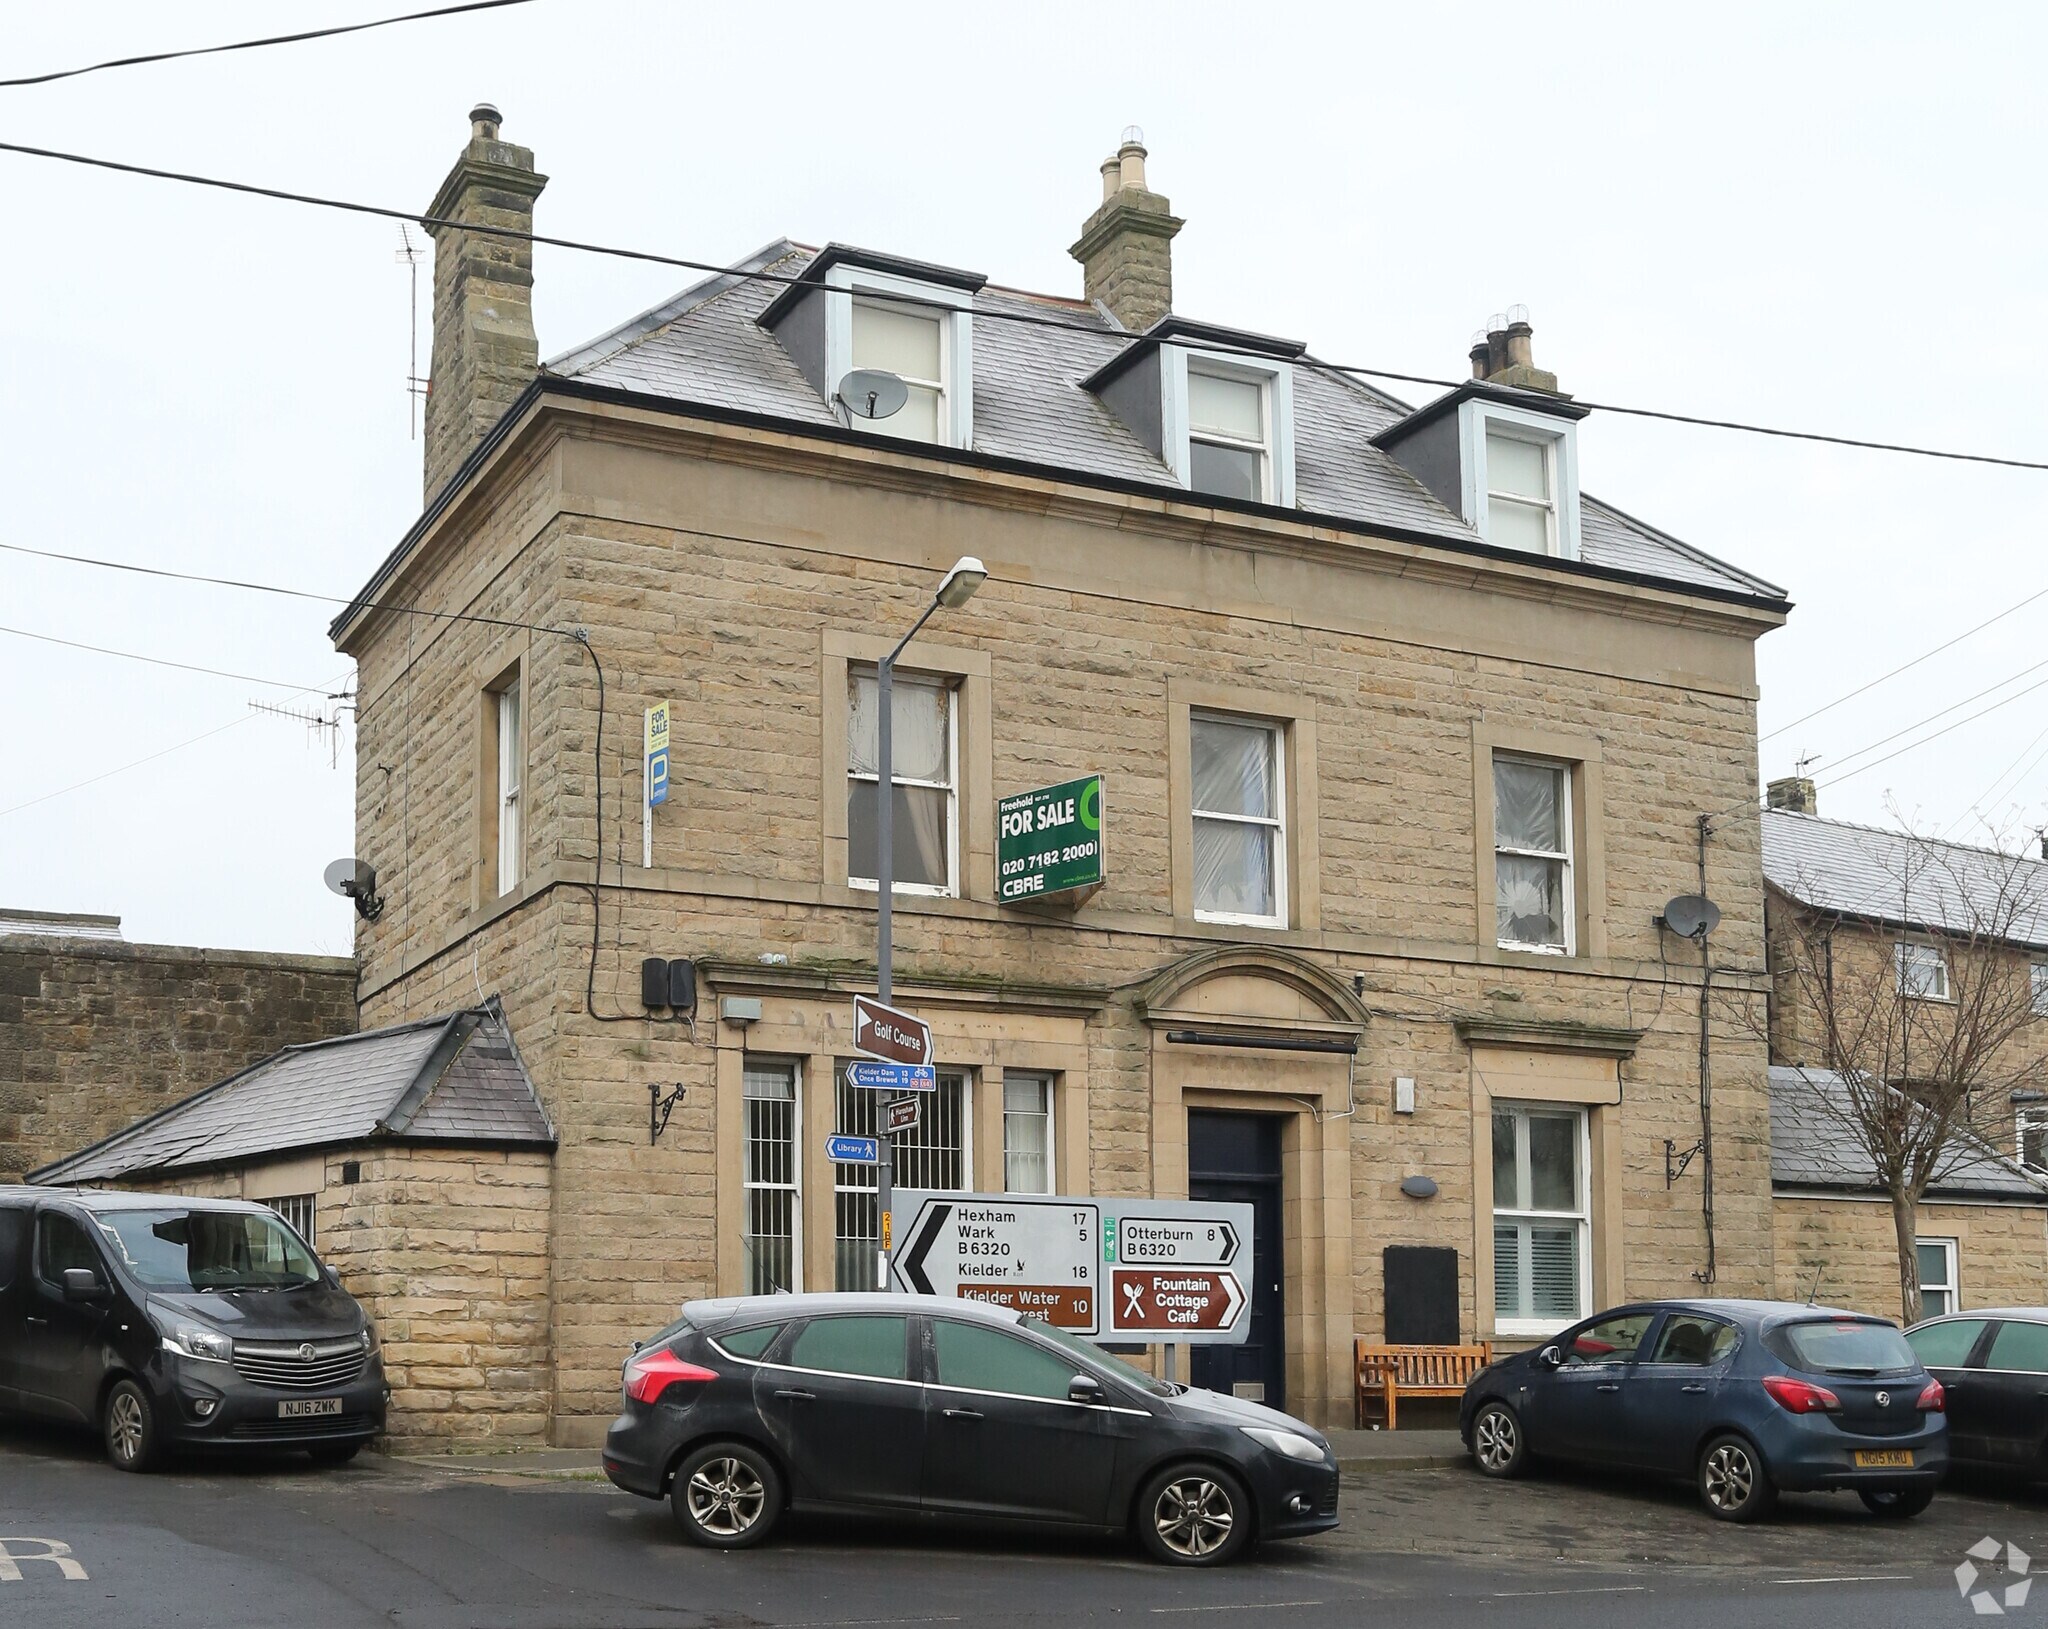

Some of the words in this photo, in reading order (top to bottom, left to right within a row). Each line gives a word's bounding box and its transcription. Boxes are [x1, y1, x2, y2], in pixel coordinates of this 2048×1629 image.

[651, 709, 665, 725] FOR
[651, 720, 668, 737] SALE
[1001, 794, 1034, 812] Freehold
[1001, 809, 1034, 839] FOR
[1037, 798, 1075, 831] SALE
[1002, 858, 1025, 875] 020
[1028, 850, 1059, 869] 7182
[1002, 874, 1045, 897] CBRE
[874, 1020, 893, 1041] Golf
[893, 1028, 921, 1051] Course
[858, 1068, 880, 1076] Kielder
[859, 1075, 874, 1083] Once
[876, 1076, 898, 1084] Brewed
[837, 1143, 862, 1154] Library
[958, 1209, 1016, 1223] Hexham
[1073, 1213, 1087, 1225] 17
[958, 1225, 995, 1239] Wark
[1079, 1229, 1087, 1242] 5
[1127, 1227, 1194, 1241] Otterburn
[1207, 1229, 1216, 1241] 8
[958, 1263, 1009, 1276] Kielder
[1072, 1266, 1088, 1279] 18
[1153, 1277, 1211, 1291] Fountain
[963, 1289, 1014, 1304] Kielder
[1019, 1290, 1061, 1305] Water
[1155, 1294, 1209, 1309] Cottage
[1073, 1300, 1088, 1314] 10
[1167, 1309, 1199, 1323] Café
[285, 1401, 311, 1415] NJ16
[314, 1400, 336, 1413] ZWK
[1861, 1451, 1886, 1465] NG15
